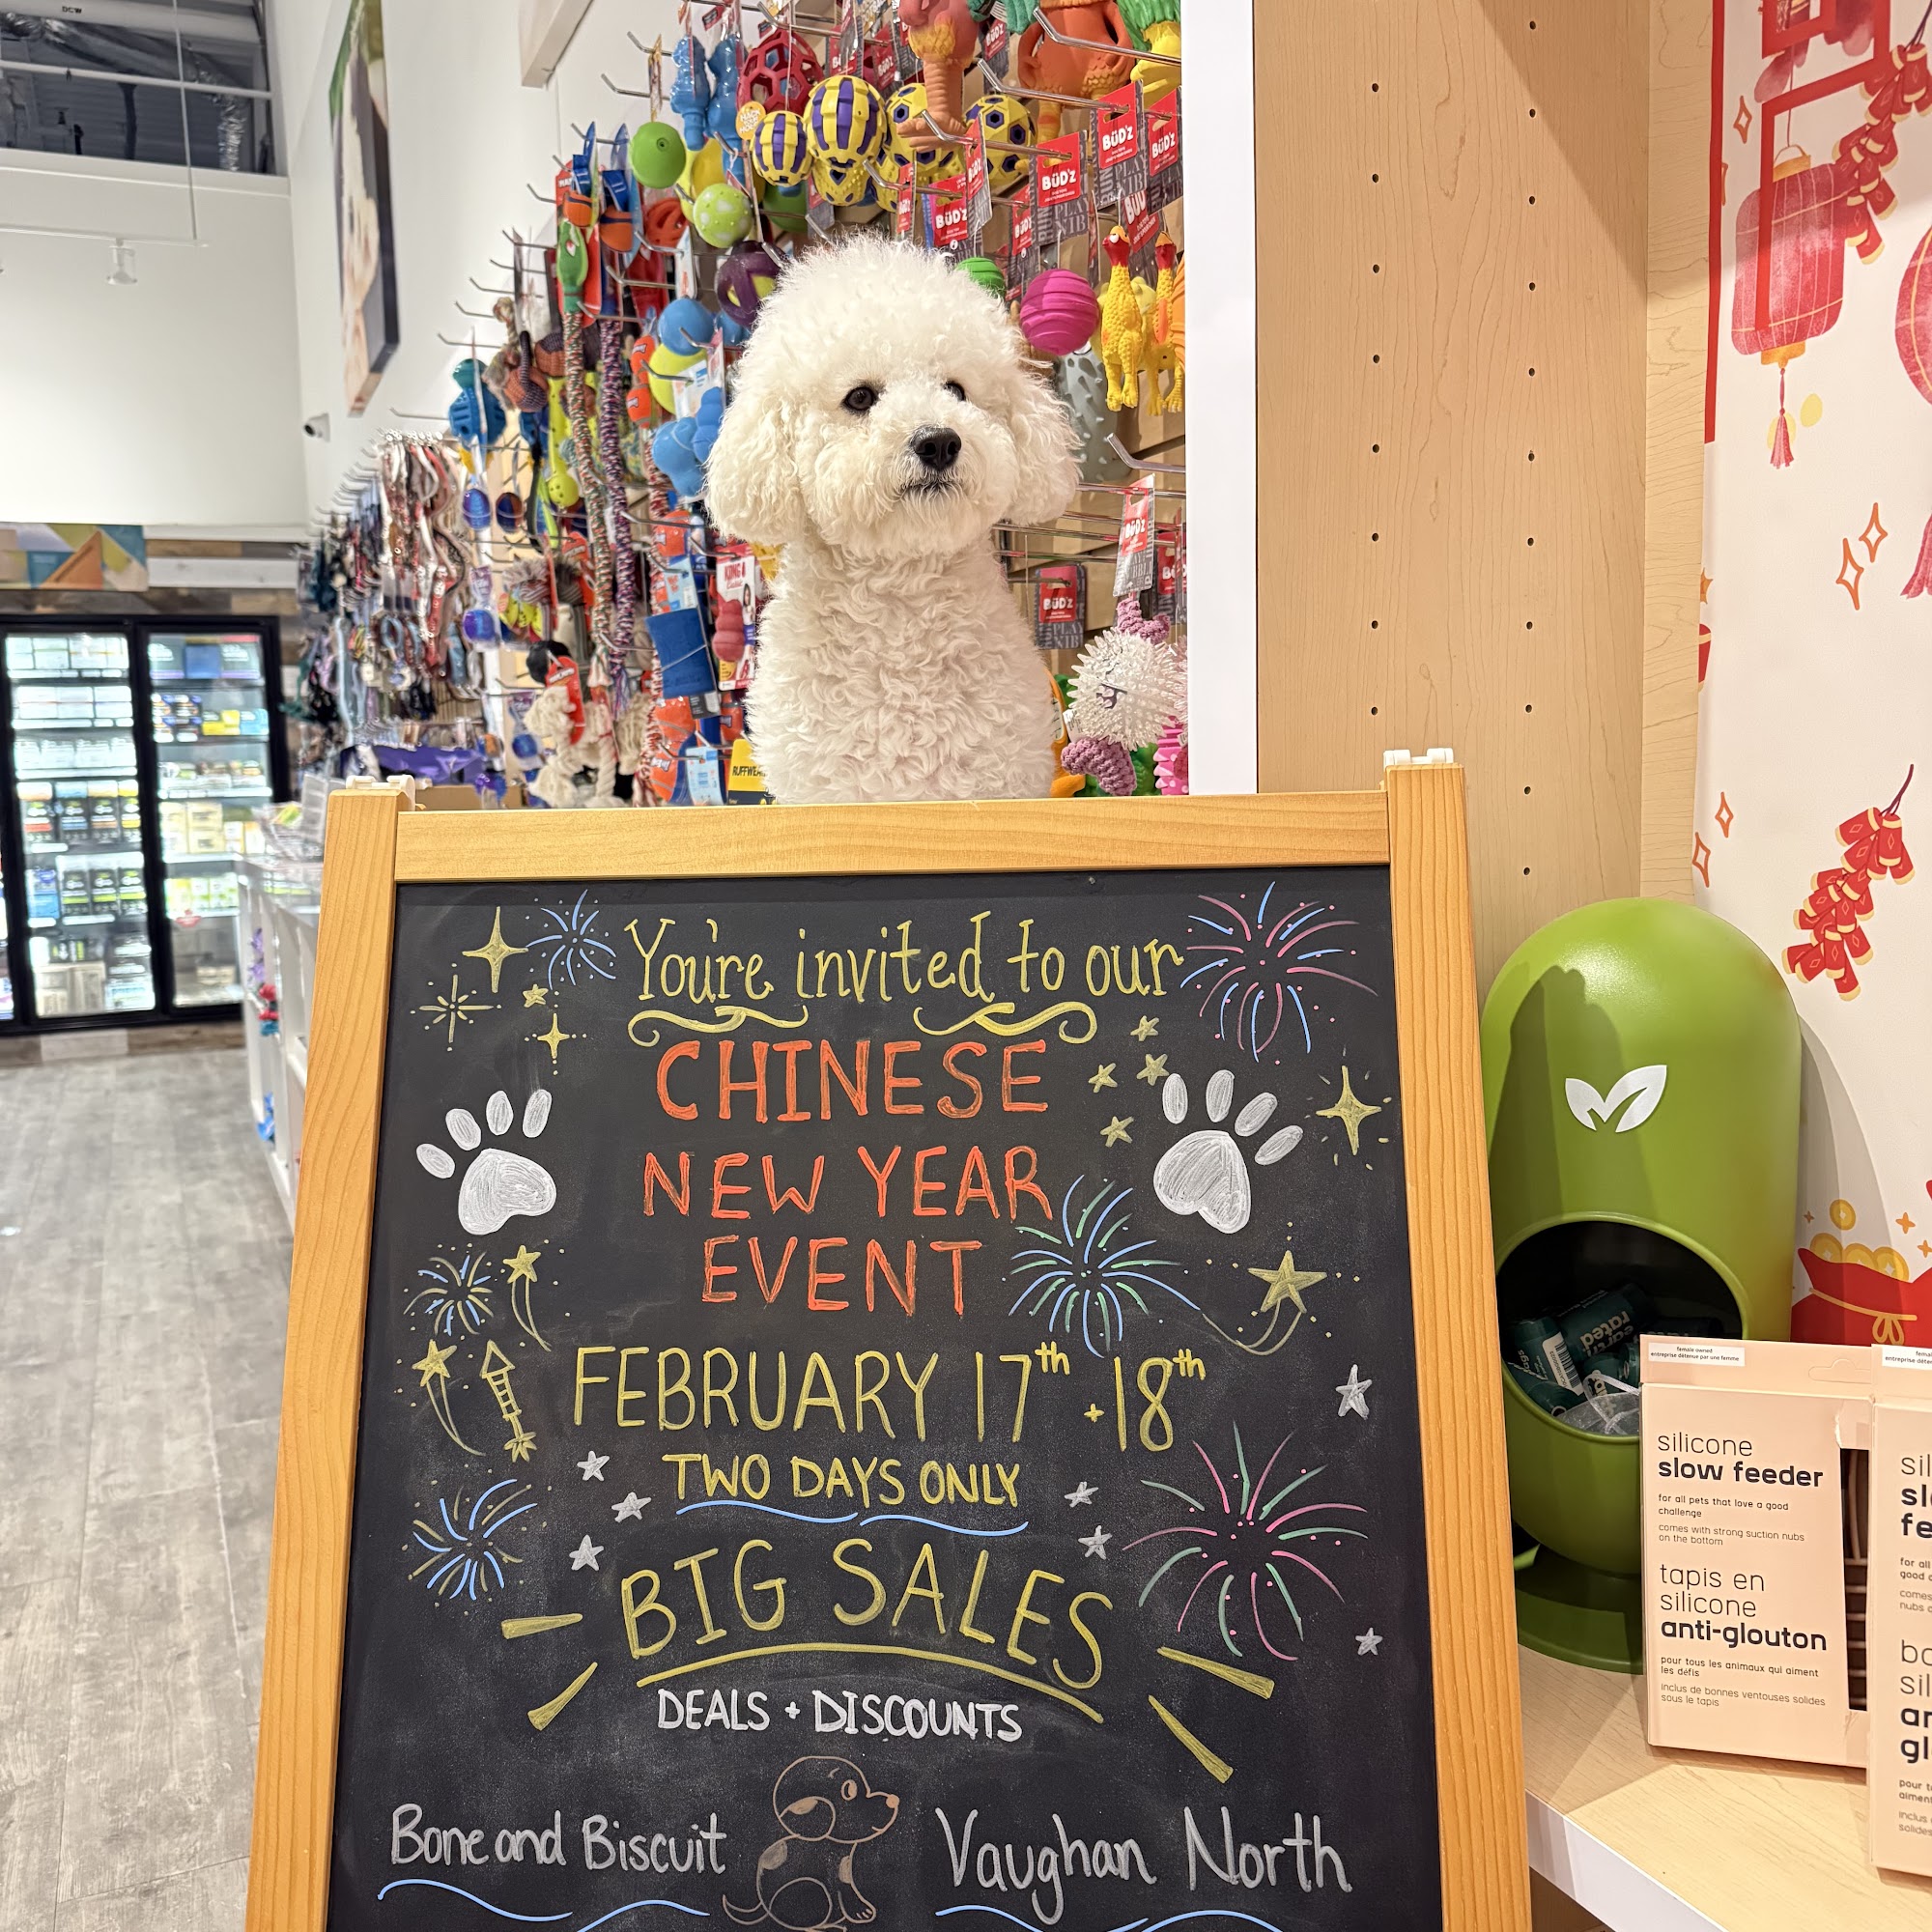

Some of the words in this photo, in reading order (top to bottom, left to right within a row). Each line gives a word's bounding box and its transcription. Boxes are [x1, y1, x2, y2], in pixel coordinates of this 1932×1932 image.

[624, 919, 775, 1004] You're
[796, 911, 995, 1002] invited
[1007, 919, 1067, 991] to
[1085, 939, 1184, 997] our
[656, 1039, 1049, 1123] CHINESE
[643, 1152, 824, 1220] NEW
[858, 1145, 1053, 1221] YEAR
[701, 1236, 982, 1318] EVENT
[1579, 1310, 1631, 1351] rated
[574, 1345, 939, 1441] FEBRUARY
[975, 1341, 1070, 1442] 17th
[1113, 1347, 1207, 1451] 18th
[1658, 1432, 1753, 1457] silicone
[663, 1453, 771, 1500] TWO
[791, 1456, 906, 1508] DAYS
[919, 1460, 1021, 1508] ONLY
[1658, 1457, 1723, 1481] slow
[1733, 1461, 1824, 1488] feeder
[1659, 1493, 1671, 1502] for
[1712, 1498, 1731, 1507] that
[1734, 1499, 1753, 1508] love
[1901, 1484, 1932, 1507] sl
[1659, 1507, 1702, 1518] challenge
[1659, 1524, 1689, 1533] comes
[1691, 1525, 1711, 1535] with
[1714, 1527, 1744, 1538] strong
[1746, 1529, 1779, 1540] suction
[1782, 1533, 1804, 1542] nubs
[1673, 1535, 1688, 1544] the
[1690, 1536, 1723, 1546] bottom
[1899, 1570, 1925, 1580] good
[1900, 1557, 1916, 1568] for
[1918, 1559, 1931, 1569] all
[1660, 1564, 1722, 1590] tapis
[1733, 1572, 1765, 1592] en
[621, 1539, 787, 1659] BIG
[833, 1539, 1113, 1690] SALES
[1661, 1591, 1757, 1617] silicone
[1899, 1601, 1924, 1612] nubs
[1661, 1620, 1828, 1651] anti-glouton
[1661, 1657, 1682, 1665] pour
[1686, 1658, 1705, 1667] tous
[1709, 1660, 1721, 1668] les
[1725, 1662, 1765, 1672] animaux
[1768, 1666, 1782, 1675] qui
[1785, 1667, 1819, 1677] aiment
[1661, 1666, 1674, 1675] les
[1677, 1666, 1700, 1677] défis
[1661, 1683, 1688, 1693] inclus
[1690, 1685, 1702, 1694] de
[1705, 1687, 1739, 1698] bonnes
[1742, 1690, 1790, 1703] ventouses
[1793, 1695, 1826, 1706] solides
[1662, 1694, 1683, 1703] sous
[1686, 1695, 1694, 1704] le
[1696, 1696, 1719, 1707] tapis
[658, 1689, 771, 1731] DEALS
[811, 1690, 1023, 1742] DISCOUNTS
[1899, 1779, 1922, 1790] pour
[1898, 1810, 1928, 1824] inclus
[390, 1803, 490, 1866] Bone
[495, 1809, 567, 1866] and
[582, 1812, 727, 1874] Biscuit
[935, 1807, 1157, 1925] Vaughan
[1183, 1806, 1352, 1892] North
